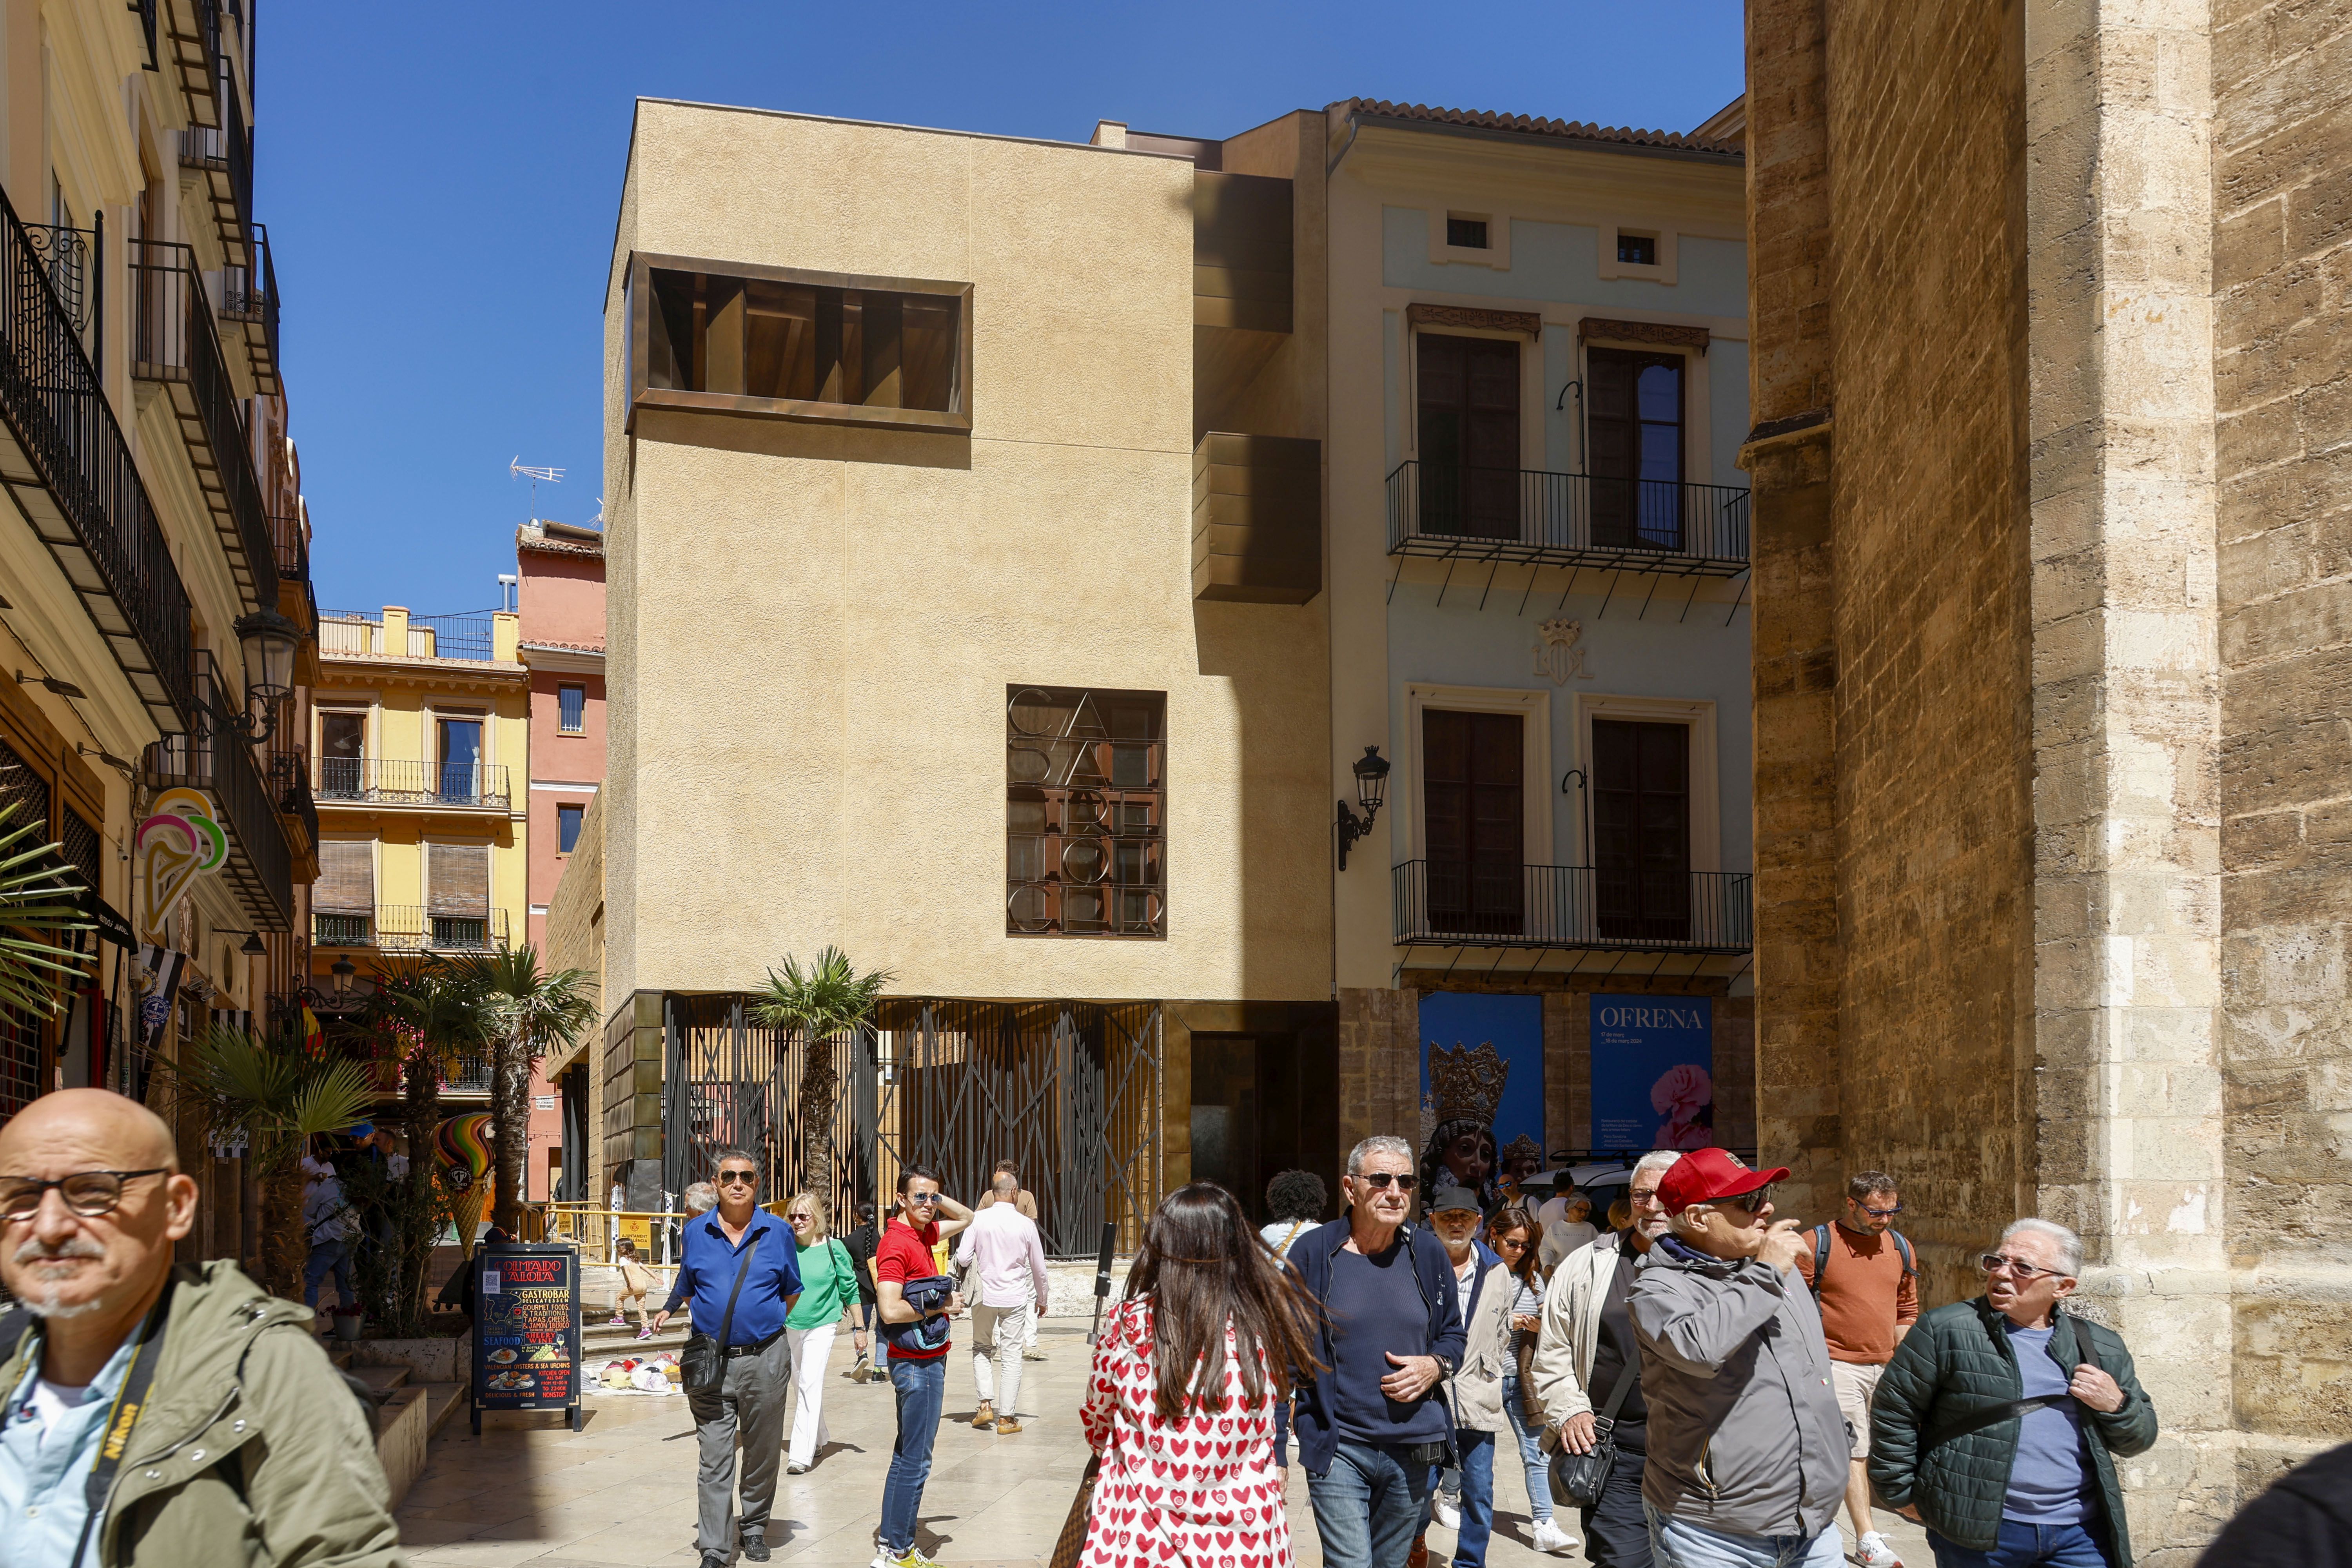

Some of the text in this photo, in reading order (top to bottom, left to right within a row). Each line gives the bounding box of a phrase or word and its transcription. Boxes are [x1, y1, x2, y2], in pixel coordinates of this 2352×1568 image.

[1600, 1007, 1703, 1029] OFRENA
[494, 1260, 561, 1271] COLMADO
[522, 1290, 570, 1298] GASTROBAR
[484, 1337, 520, 1345] SEAFOOD
[103, 1403, 139, 1460] Nikon
